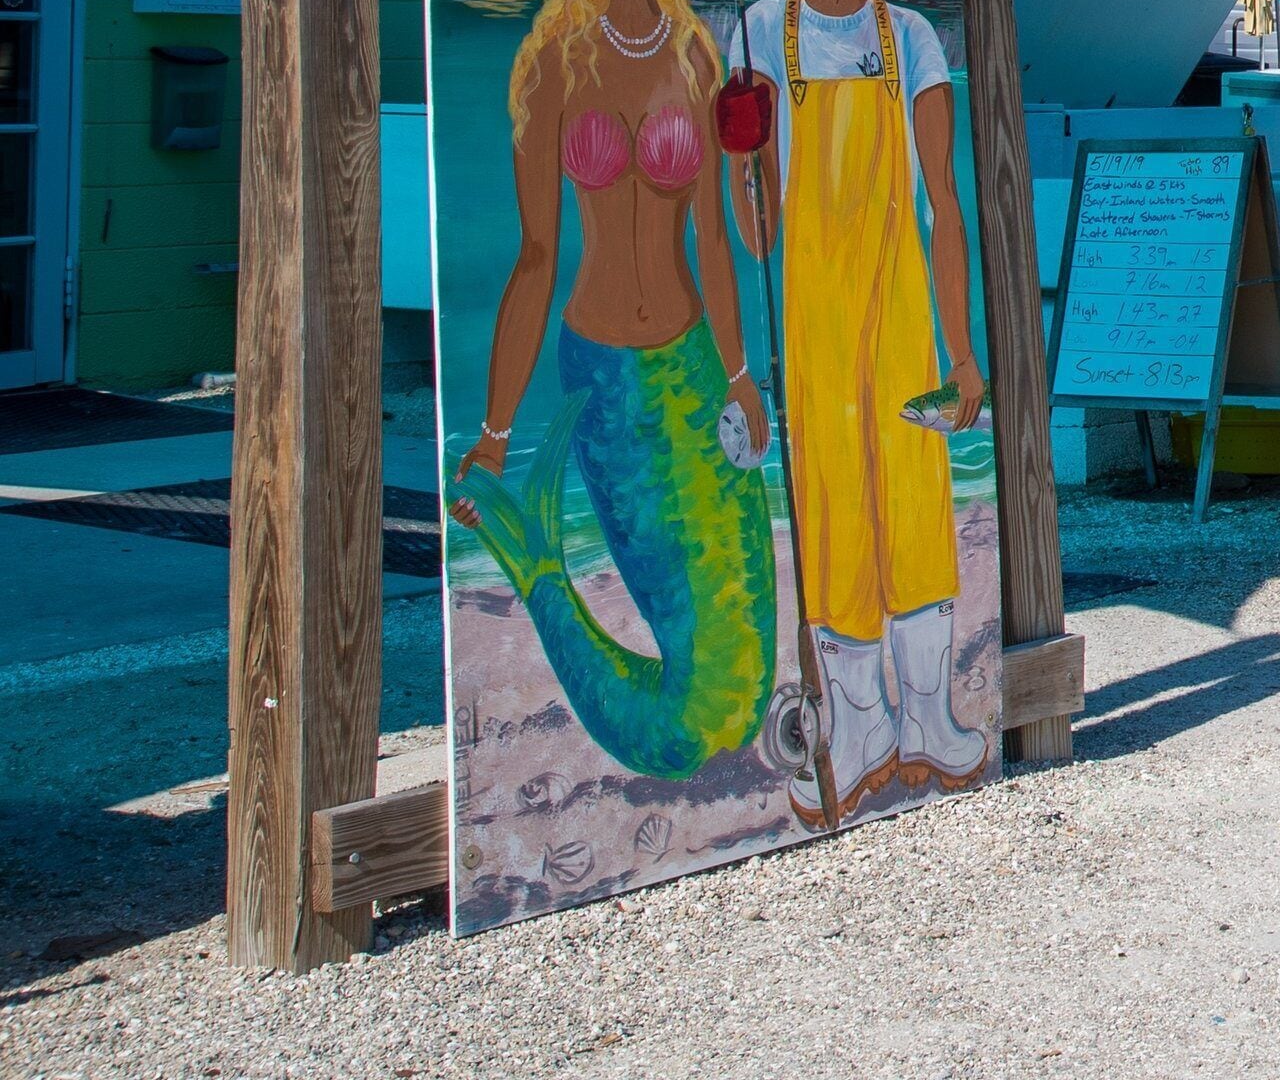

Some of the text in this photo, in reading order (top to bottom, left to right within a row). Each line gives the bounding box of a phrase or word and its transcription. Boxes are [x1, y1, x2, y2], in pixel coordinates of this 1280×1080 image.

[785, 32, 798, 77] HELLY
[882, 34, 895, 75] HELLY
[1089, 154, 1145, 175] 5/19/19
[1159, 180, 1167, 191] 5
[1080, 210, 1136, 224] Scattered
[1080, 226, 1168, 239] Late Afternoon
[1077, 247, 1102, 267] High
[1072, 300, 1098, 321] High
[1072, 356, 1135, 384] Sunset
